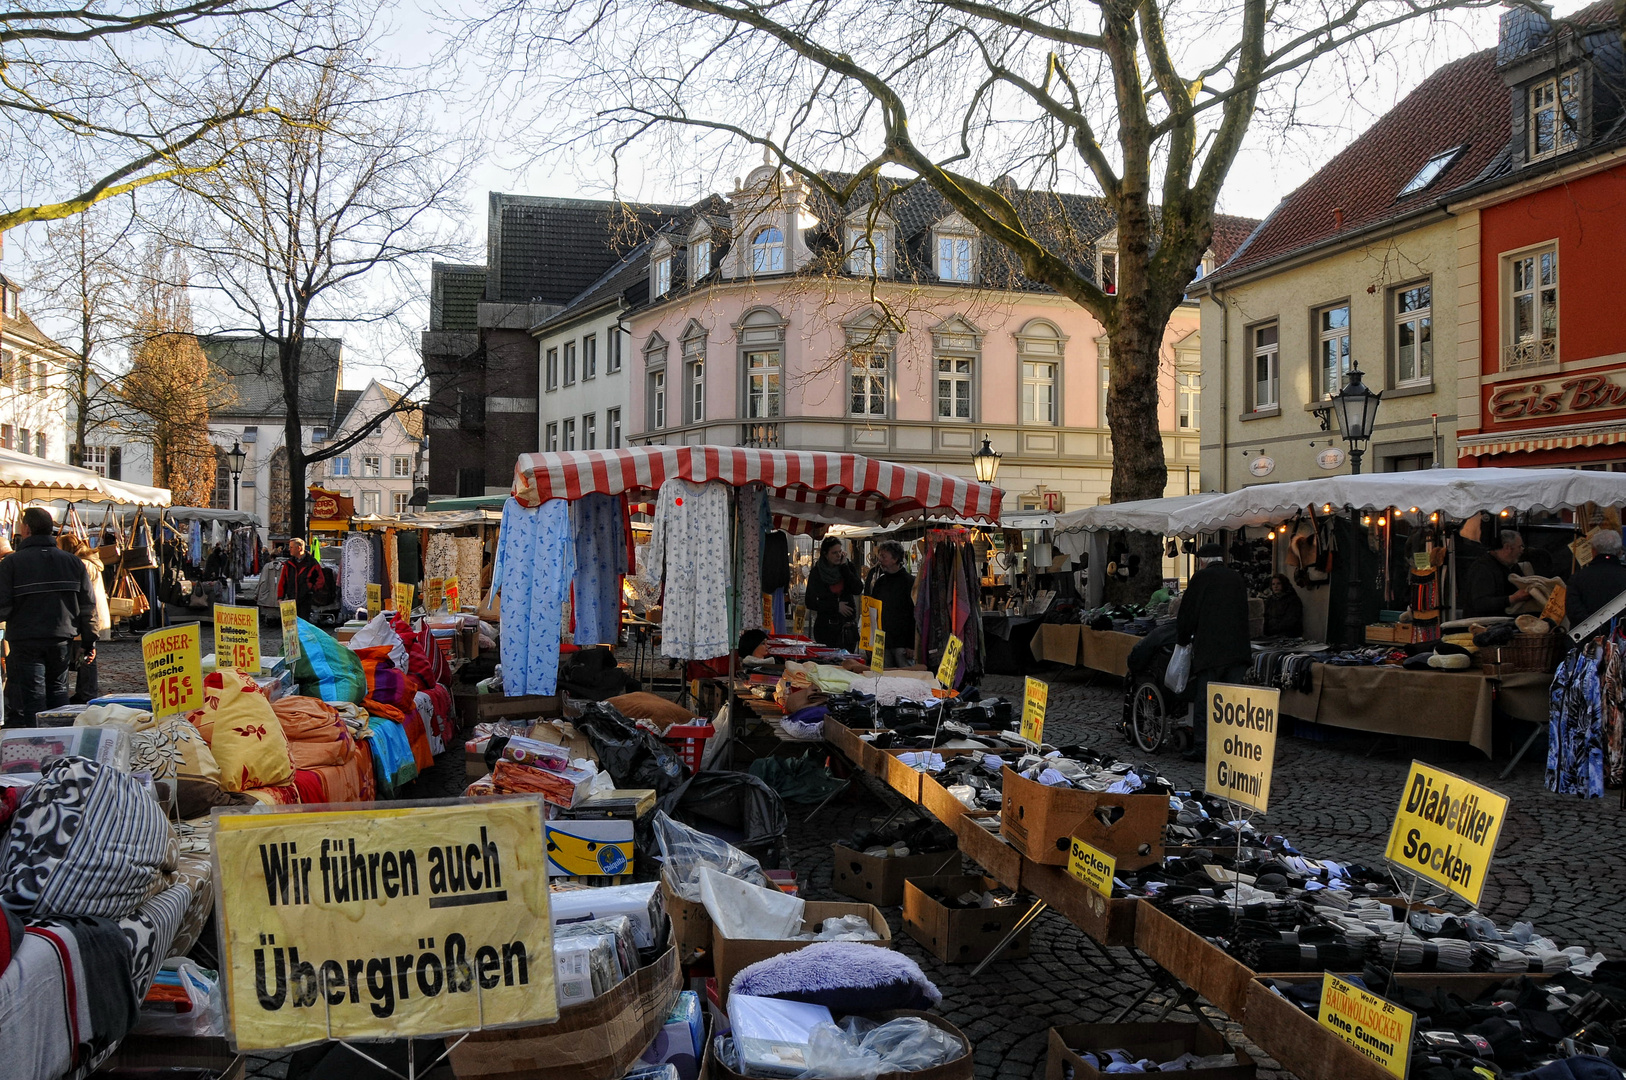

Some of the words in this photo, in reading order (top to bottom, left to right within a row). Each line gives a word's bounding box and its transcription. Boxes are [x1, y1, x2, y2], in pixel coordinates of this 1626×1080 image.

[1493, 386, 1562, 418] Eis
[1561, 375, 1626, 410] Br
[1044, 494, 1058, 510] T
[1213, 693, 1274, 733] Socken
[1224, 735, 1262, 761] ohne
[1217, 761, 1263, 798] Gummi
[1405, 773, 1495, 847] Diabetiker
[259, 841, 311, 906] Wir
[320, 838, 419, 904] führen
[428, 826, 501, 894] auch
[603, 856, 626, 874] Chiquita
[1072, 843, 1111, 877] Socken
[1403, 829, 1472, 888] Socken
[254, 933, 529, 1018] Übergrößen
[1326, 987, 1404, 1043] BAUMWOLLSOCKEN
[1328, 1013, 1352, 1034] ohne
[1355, 1025, 1394, 1057] Gummi
